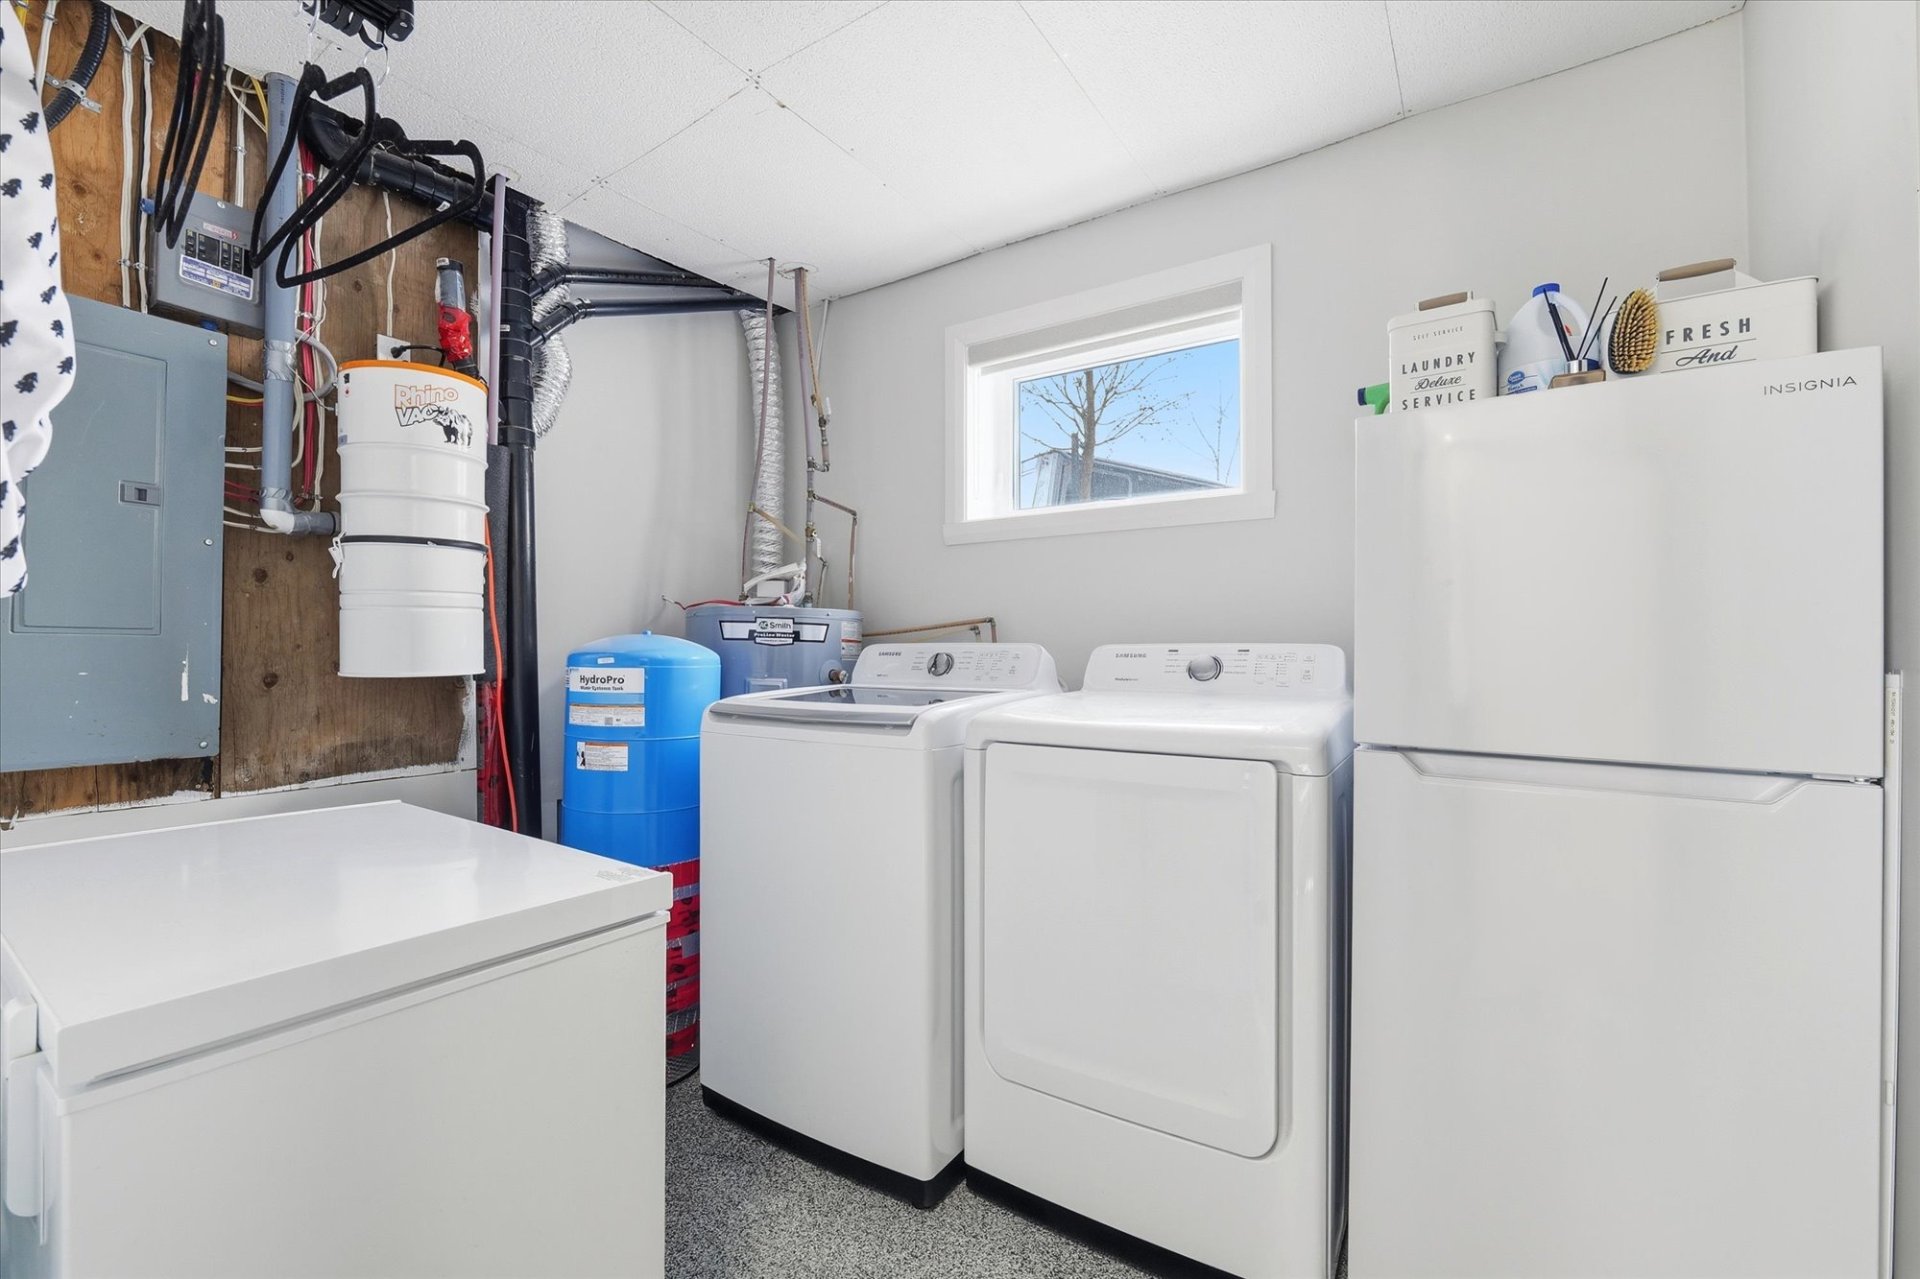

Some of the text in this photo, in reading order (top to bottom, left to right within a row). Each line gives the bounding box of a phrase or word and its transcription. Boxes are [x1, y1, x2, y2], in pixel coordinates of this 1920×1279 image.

[1665, 317, 1751, 345] FRESH
[1401, 351, 1476, 375] LAUNDRY
[1675, 345, 1739, 367] And
[1414, 375, 1462, 391] Deluxe
[1763, 375, 1857, 396] INSIGNIA
[394, 384, 459, 408] Rhino
[1402, 388, 1476, 411] SERVICE
[769, 621, 792, 630] Smith
[579, 674, 625, 686] HydroPro
